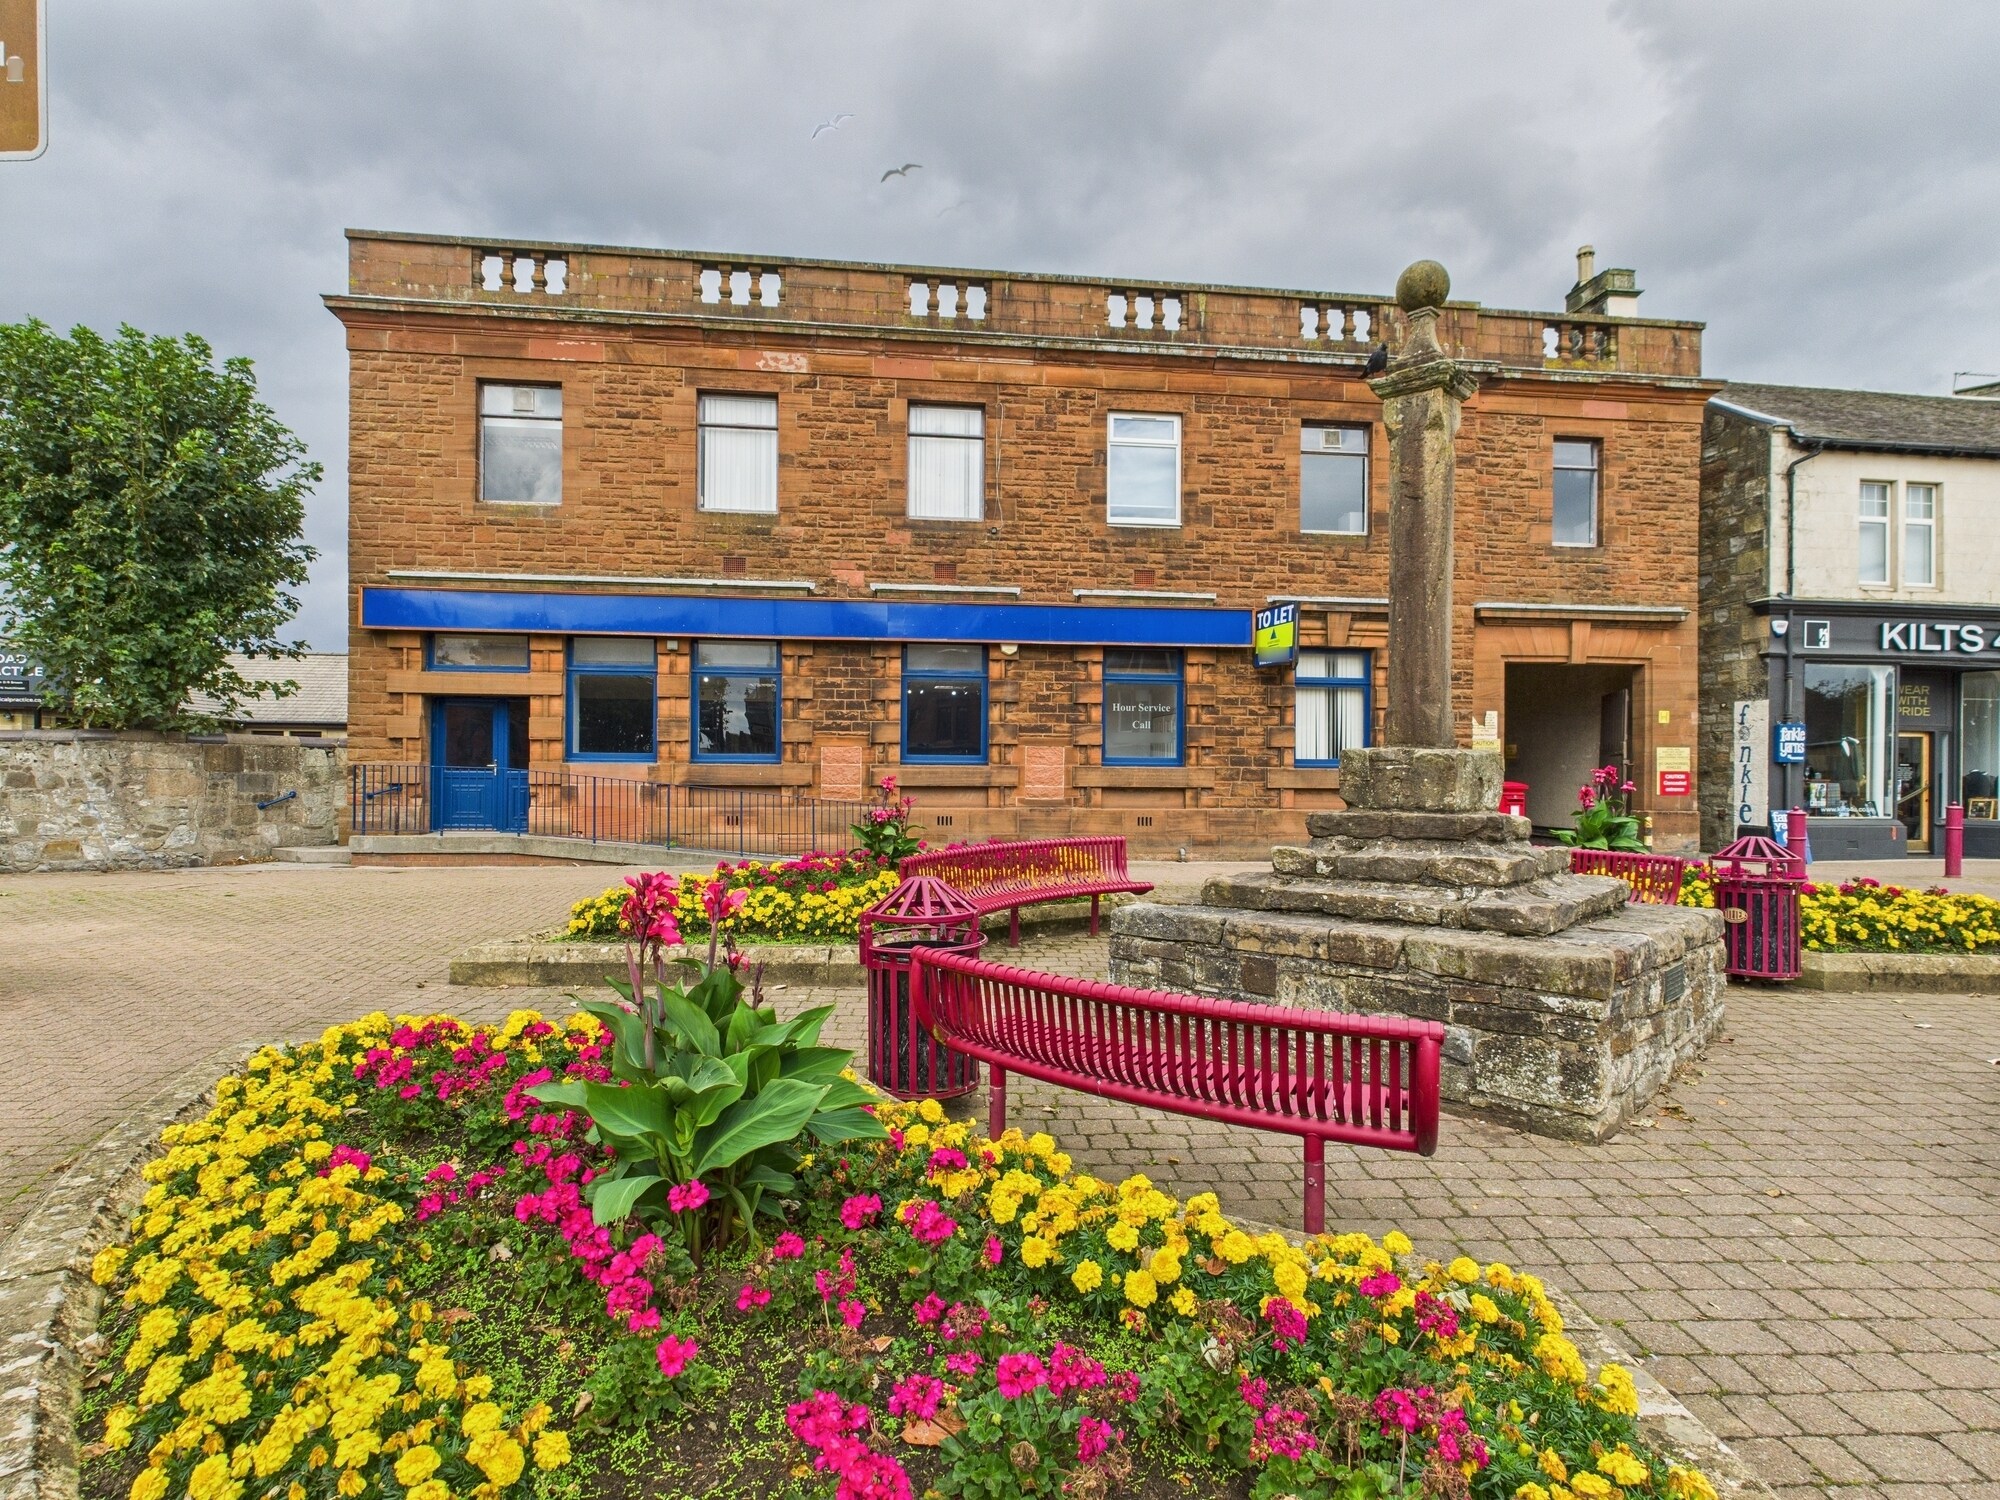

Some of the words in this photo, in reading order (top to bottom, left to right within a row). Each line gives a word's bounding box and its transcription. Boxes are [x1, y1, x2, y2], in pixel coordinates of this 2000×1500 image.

[1257, 611, 1271, 629] TO
[1273, 605, 1295, 625] LET
[1882, 623, 1985, 653] KILTS
[1112, 703, 1136, 712] Hour
[1138, 703, 1171, 712] Service
[1132, 720, 1151, 729] Call
[1780, 727, 1805, 741] fankle
[1780, 742, 1805, 757] yarns
